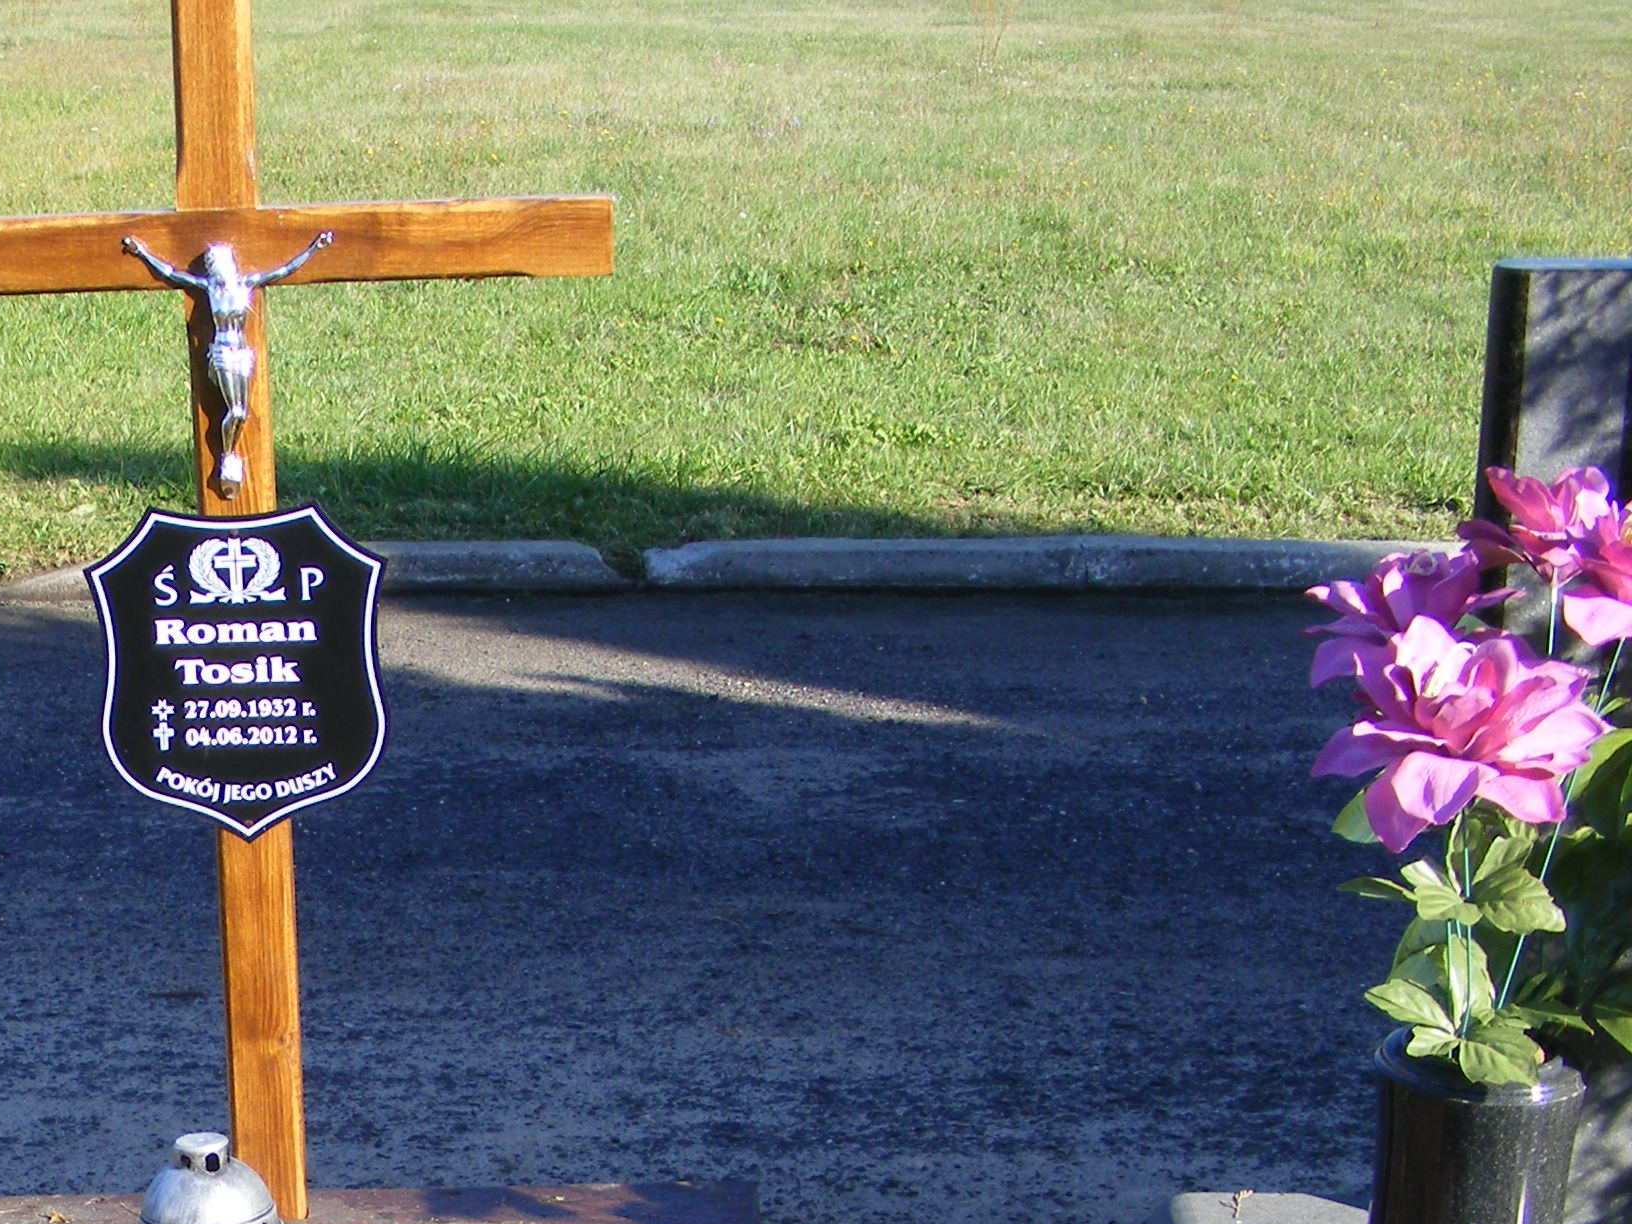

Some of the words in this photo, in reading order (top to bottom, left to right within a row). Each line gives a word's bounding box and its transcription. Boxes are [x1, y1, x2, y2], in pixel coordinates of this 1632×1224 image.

[153, 565, 179, 607] Ś
[299, 567, 325, 601] P
[154, 618, 318, 645] Roman
[174, 656, 301, 685] Tosik
[183, 698, 297, 719] 27.09.1932
[302, 700, 317, 718] r.
[185, 726, 298, 747] 04.06.2012
[303, 727, 318, 745] r.
[155, 766, 221, 803] POKÓJ
[223, 781, 274, 804] JEGO
[275, 762, 338, 799] DUSZY
